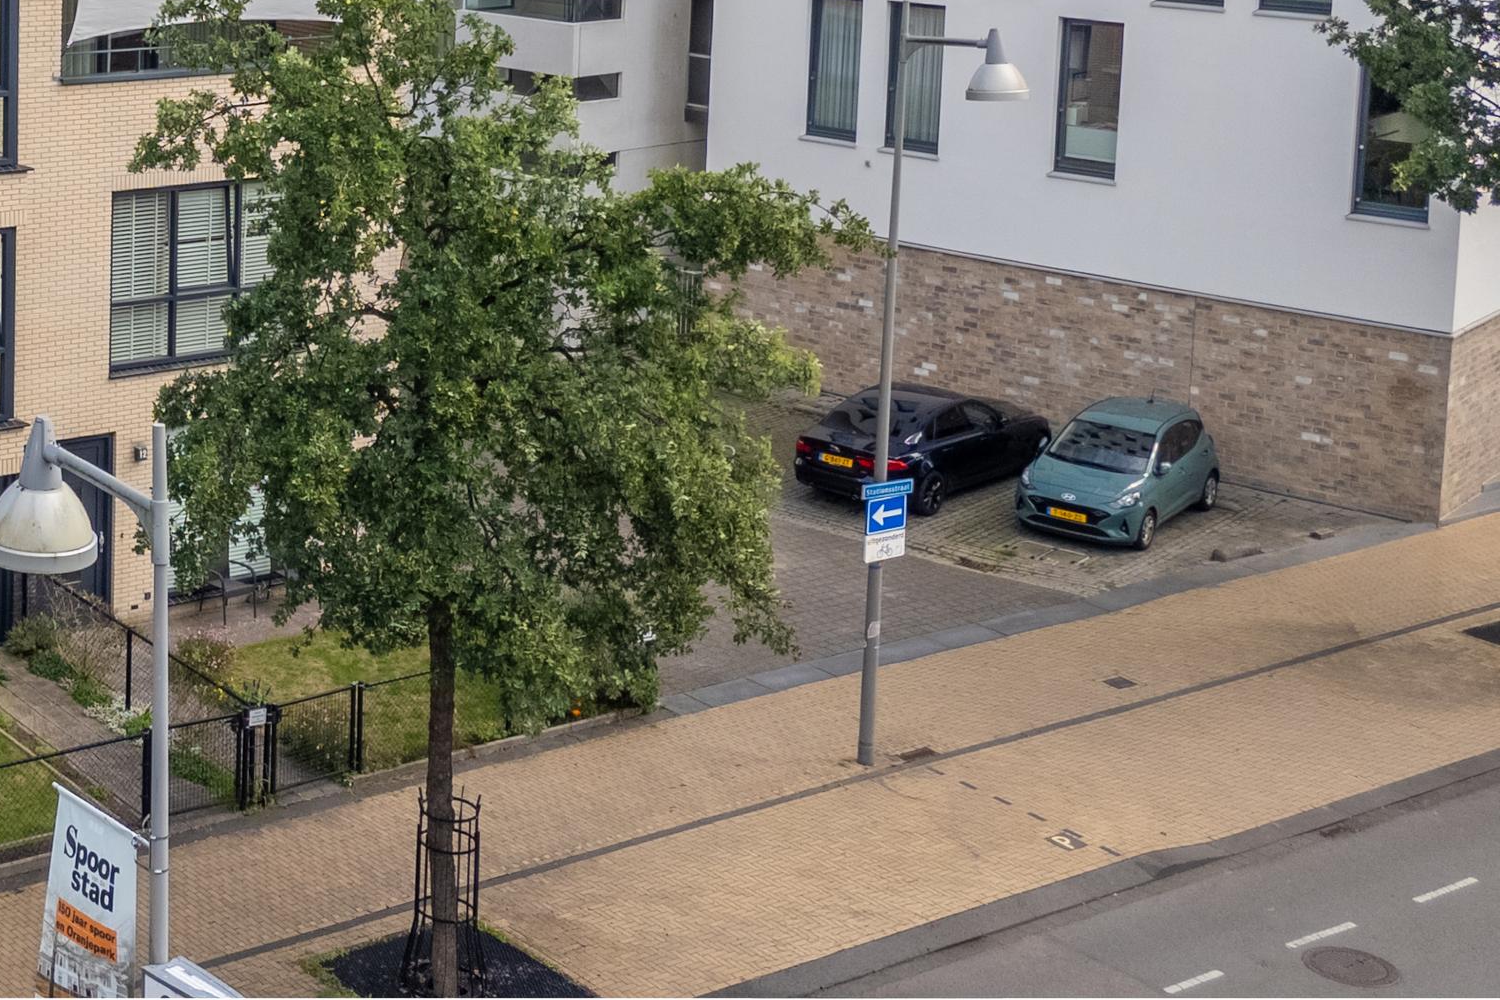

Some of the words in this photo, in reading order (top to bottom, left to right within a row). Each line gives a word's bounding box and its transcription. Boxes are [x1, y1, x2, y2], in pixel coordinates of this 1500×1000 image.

[866, 483, 910, 497] Stationsstraat
[63, 824, 120, 885] Spoor
[71, 870, 114, 913] stad
[56, 920, 65, 933] en
[66, 925, 115, 961] Oranjepark
[58, 899, 71, 918] 150
[72, 910, 87, 928] jaar
[89, 924, 115, 943] spoor
